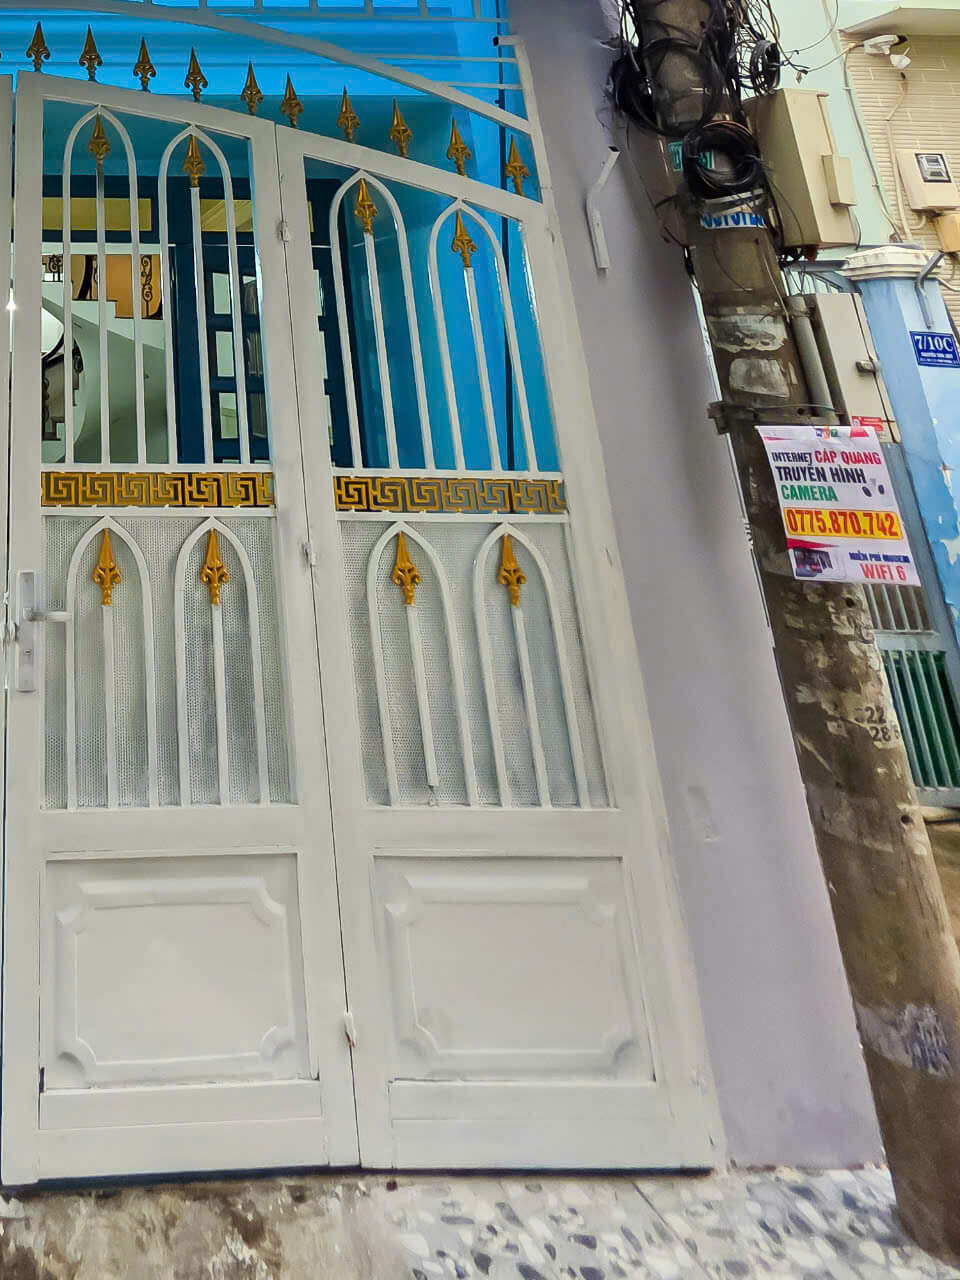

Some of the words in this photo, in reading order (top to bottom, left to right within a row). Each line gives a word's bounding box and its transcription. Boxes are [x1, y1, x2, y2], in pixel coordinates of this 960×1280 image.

[914, 335, 954, 352] 7/10C
[841, 451, 882, 465] QUANG
[781, 484, 839, 502] CAMERA
[786, 509, 899, 536] 0775.870.742
[859, 563, 894, 580] WIFI
[896, 565, 906, 581] 6
